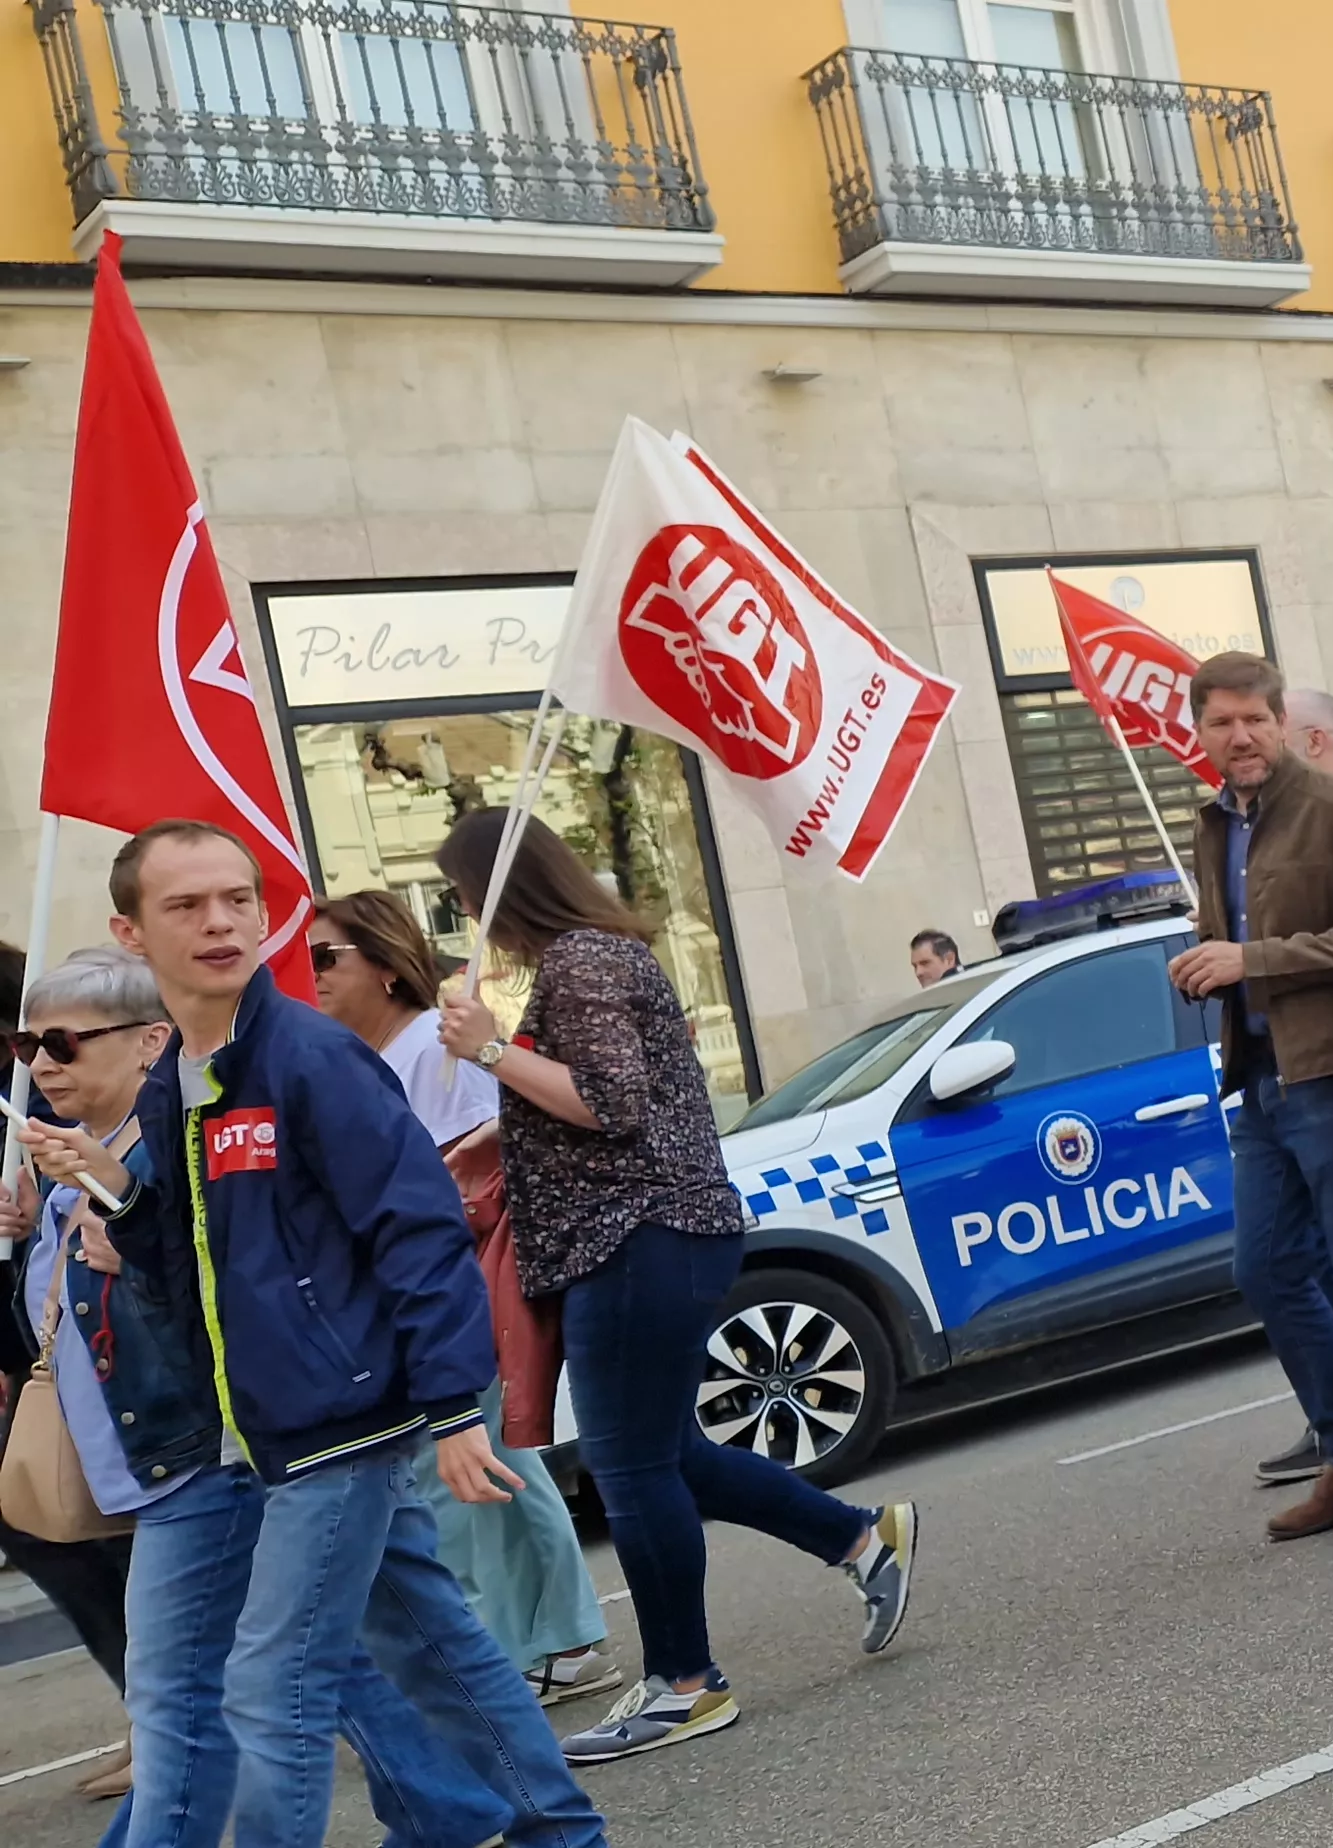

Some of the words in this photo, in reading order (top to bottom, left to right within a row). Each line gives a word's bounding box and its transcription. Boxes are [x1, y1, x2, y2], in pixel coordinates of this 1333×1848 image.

[295, 622, 461, 678] Pilar
[485, 616, 559, 667] Pr
[668, 533, 807, 714] UGT
[785, 673, 888, 858] www.UGT.es
[213, 1123, 249, 1155] UGT
[951, 1165, 1213, 1267] POLICIA
